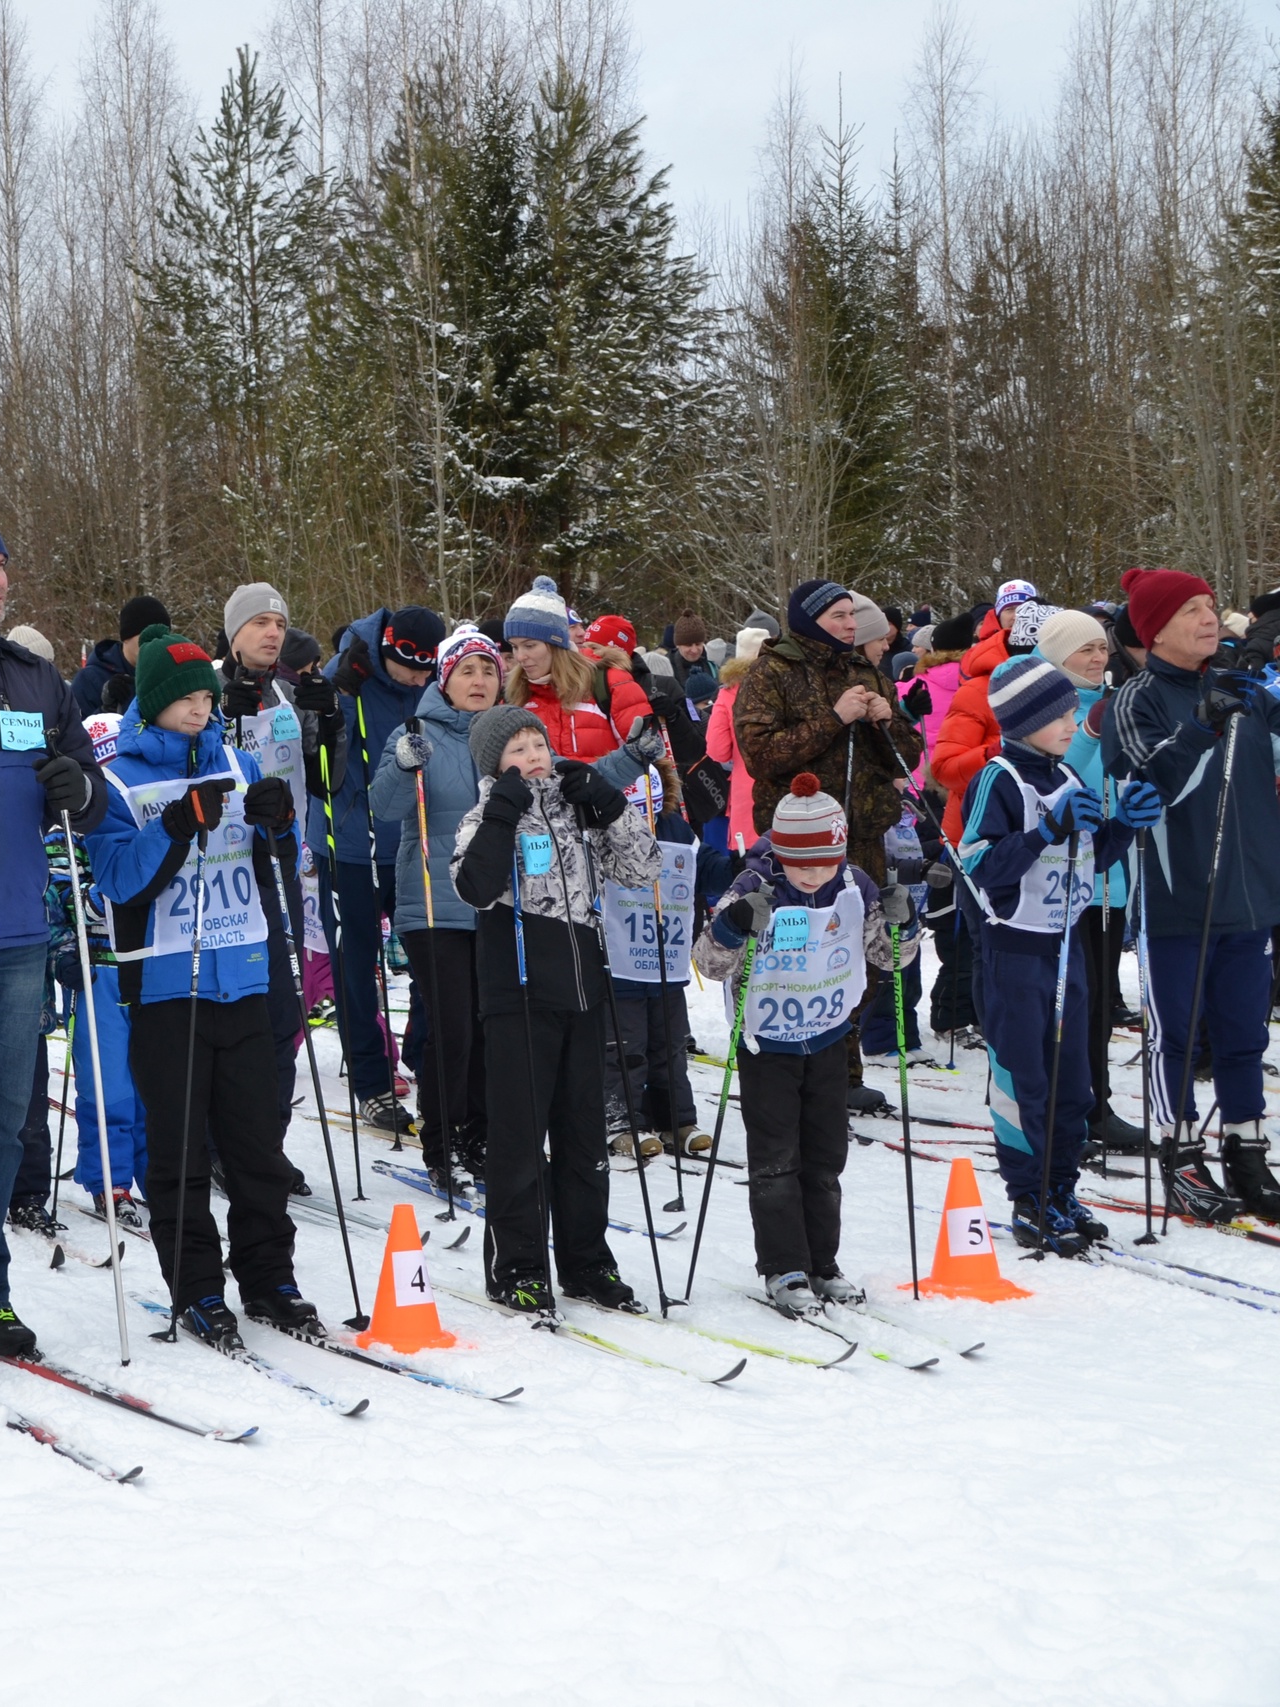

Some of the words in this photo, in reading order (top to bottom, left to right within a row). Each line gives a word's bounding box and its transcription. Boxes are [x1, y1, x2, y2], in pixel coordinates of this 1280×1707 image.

[1, 717, 41, 728] СЕМЬЯ
[7, 730, 15, 743] 3
[698, 770, 725, 809] adidas
[169, 866, 251, 917] 2910
[180, 912, 248, 934] КИОВСКАЯ
[775, 917, 807, 927] ЕМЬЯ
[629, 947, 678, 959] КИРОВКАЯ
[289, 952, 300, 977] TREK
[635, 960, 674, 971] ОБЛАТЬ
[754, 955, 807, 974] 2022
[751, 982, 779, 993] СПОРТ
[758, 988, 844, 1032] 2928
[968, 1219, 983, 1245] 5
[1212, 1223, 1248, 1238] ATOMIC
[411, 1265, 425, 1292] 4
